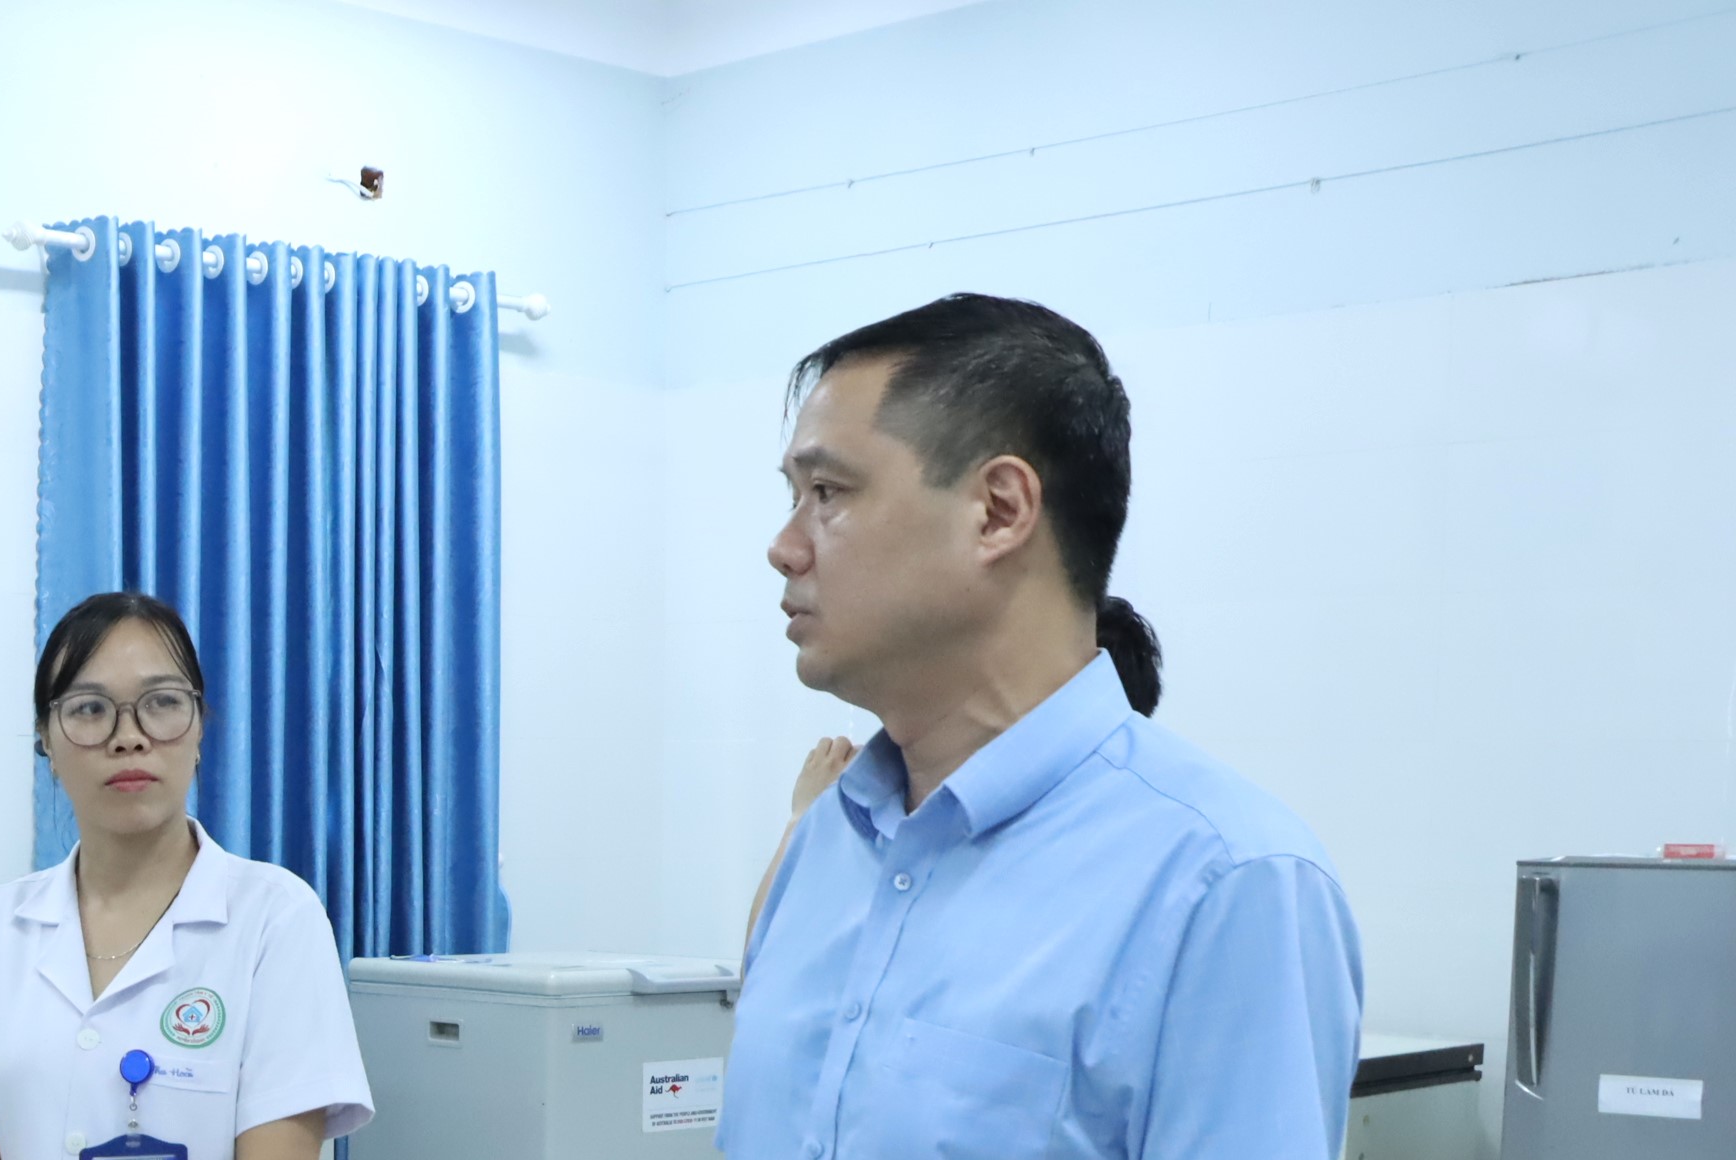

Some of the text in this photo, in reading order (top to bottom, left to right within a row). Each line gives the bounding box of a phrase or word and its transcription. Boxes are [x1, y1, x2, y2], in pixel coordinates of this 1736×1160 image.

[577, 1024, 601, 1036] Haier
[650, 1073, 689, 1085] Australian
[650, 1085, 663, 1095] Aid
